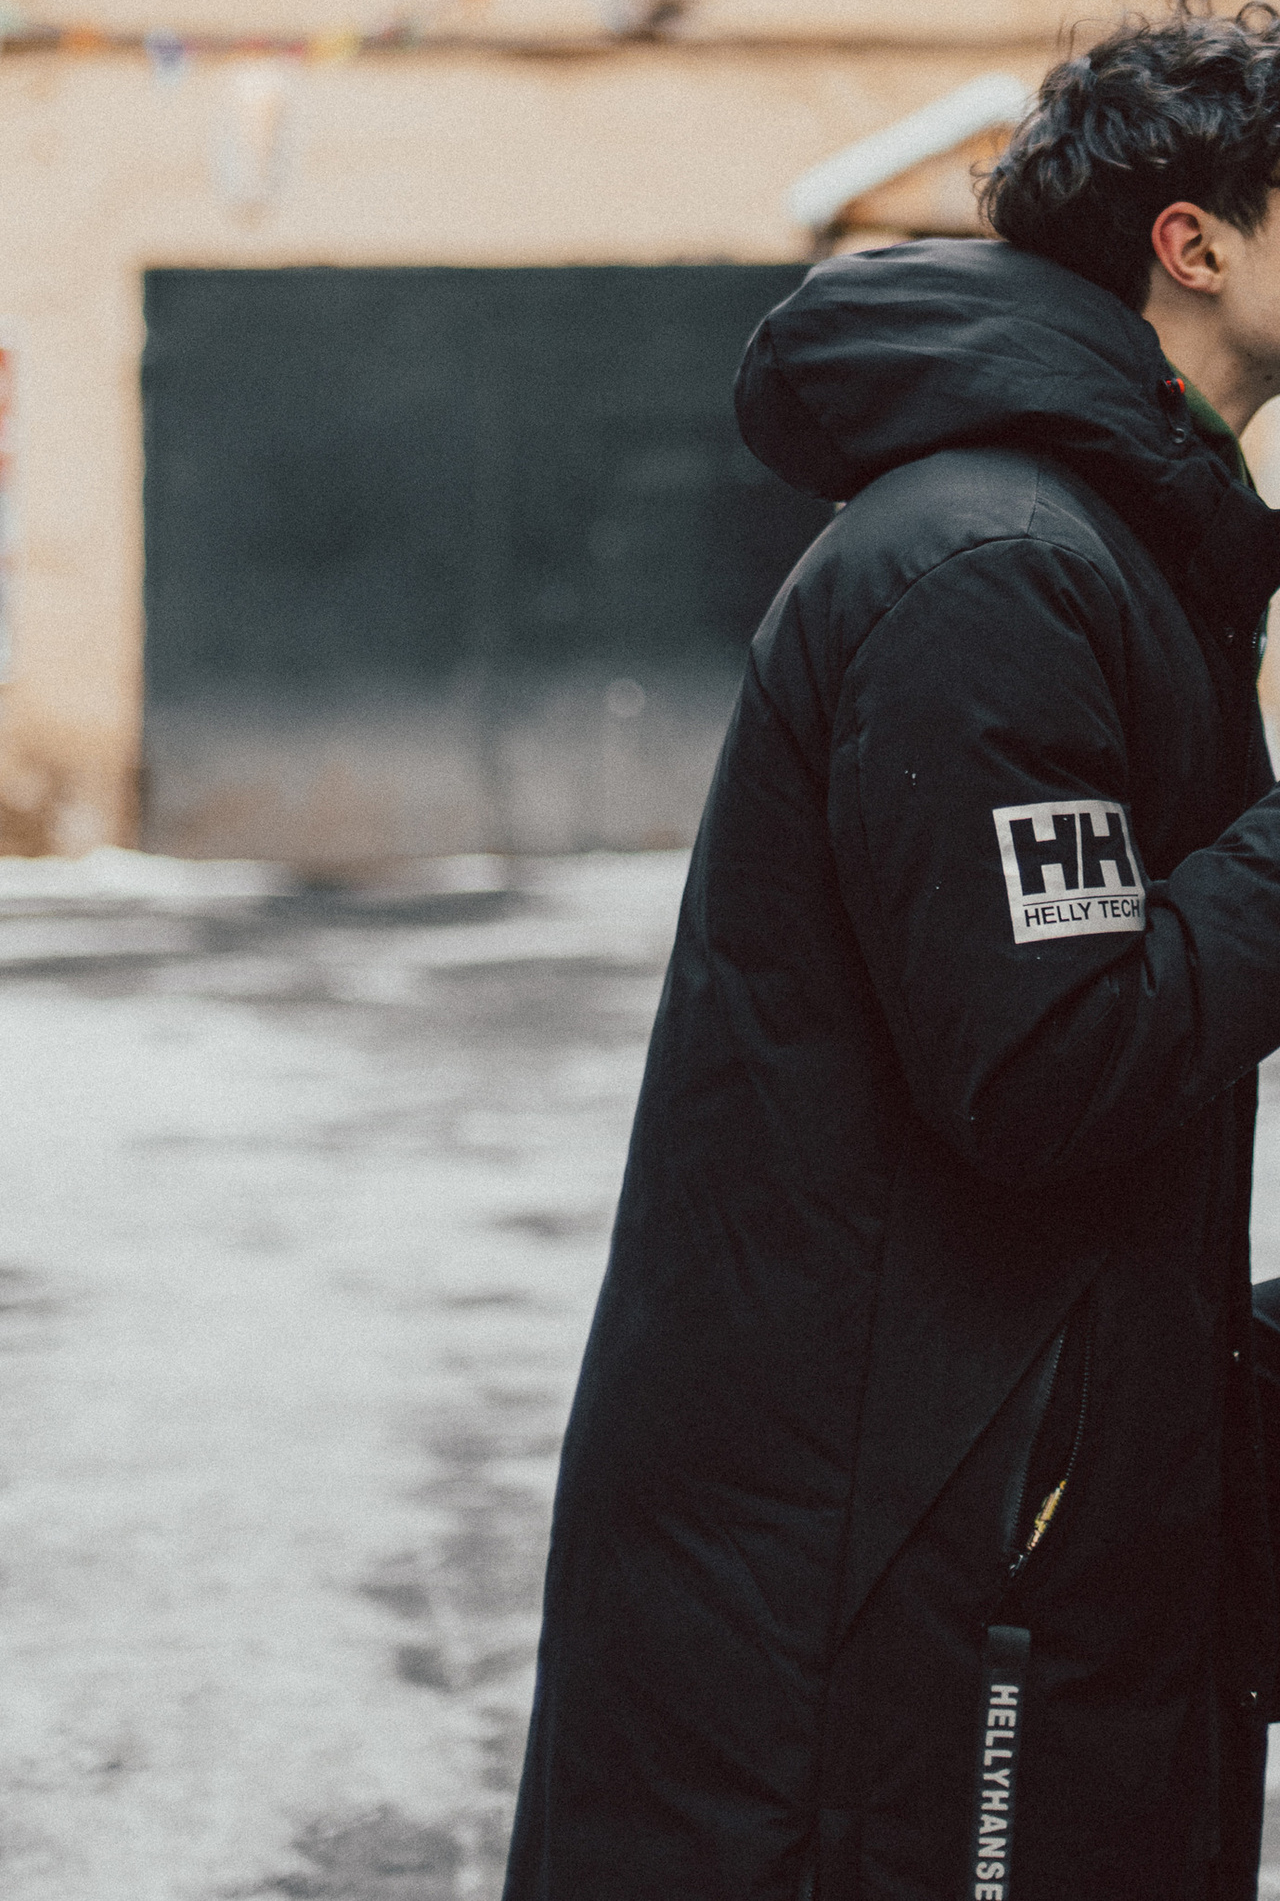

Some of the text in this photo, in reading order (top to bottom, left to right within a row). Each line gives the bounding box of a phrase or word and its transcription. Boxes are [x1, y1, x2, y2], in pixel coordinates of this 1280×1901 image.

[1008, 812, 1136, 896] HH
[1024, 899, 1140, 927] HELLY TECH
